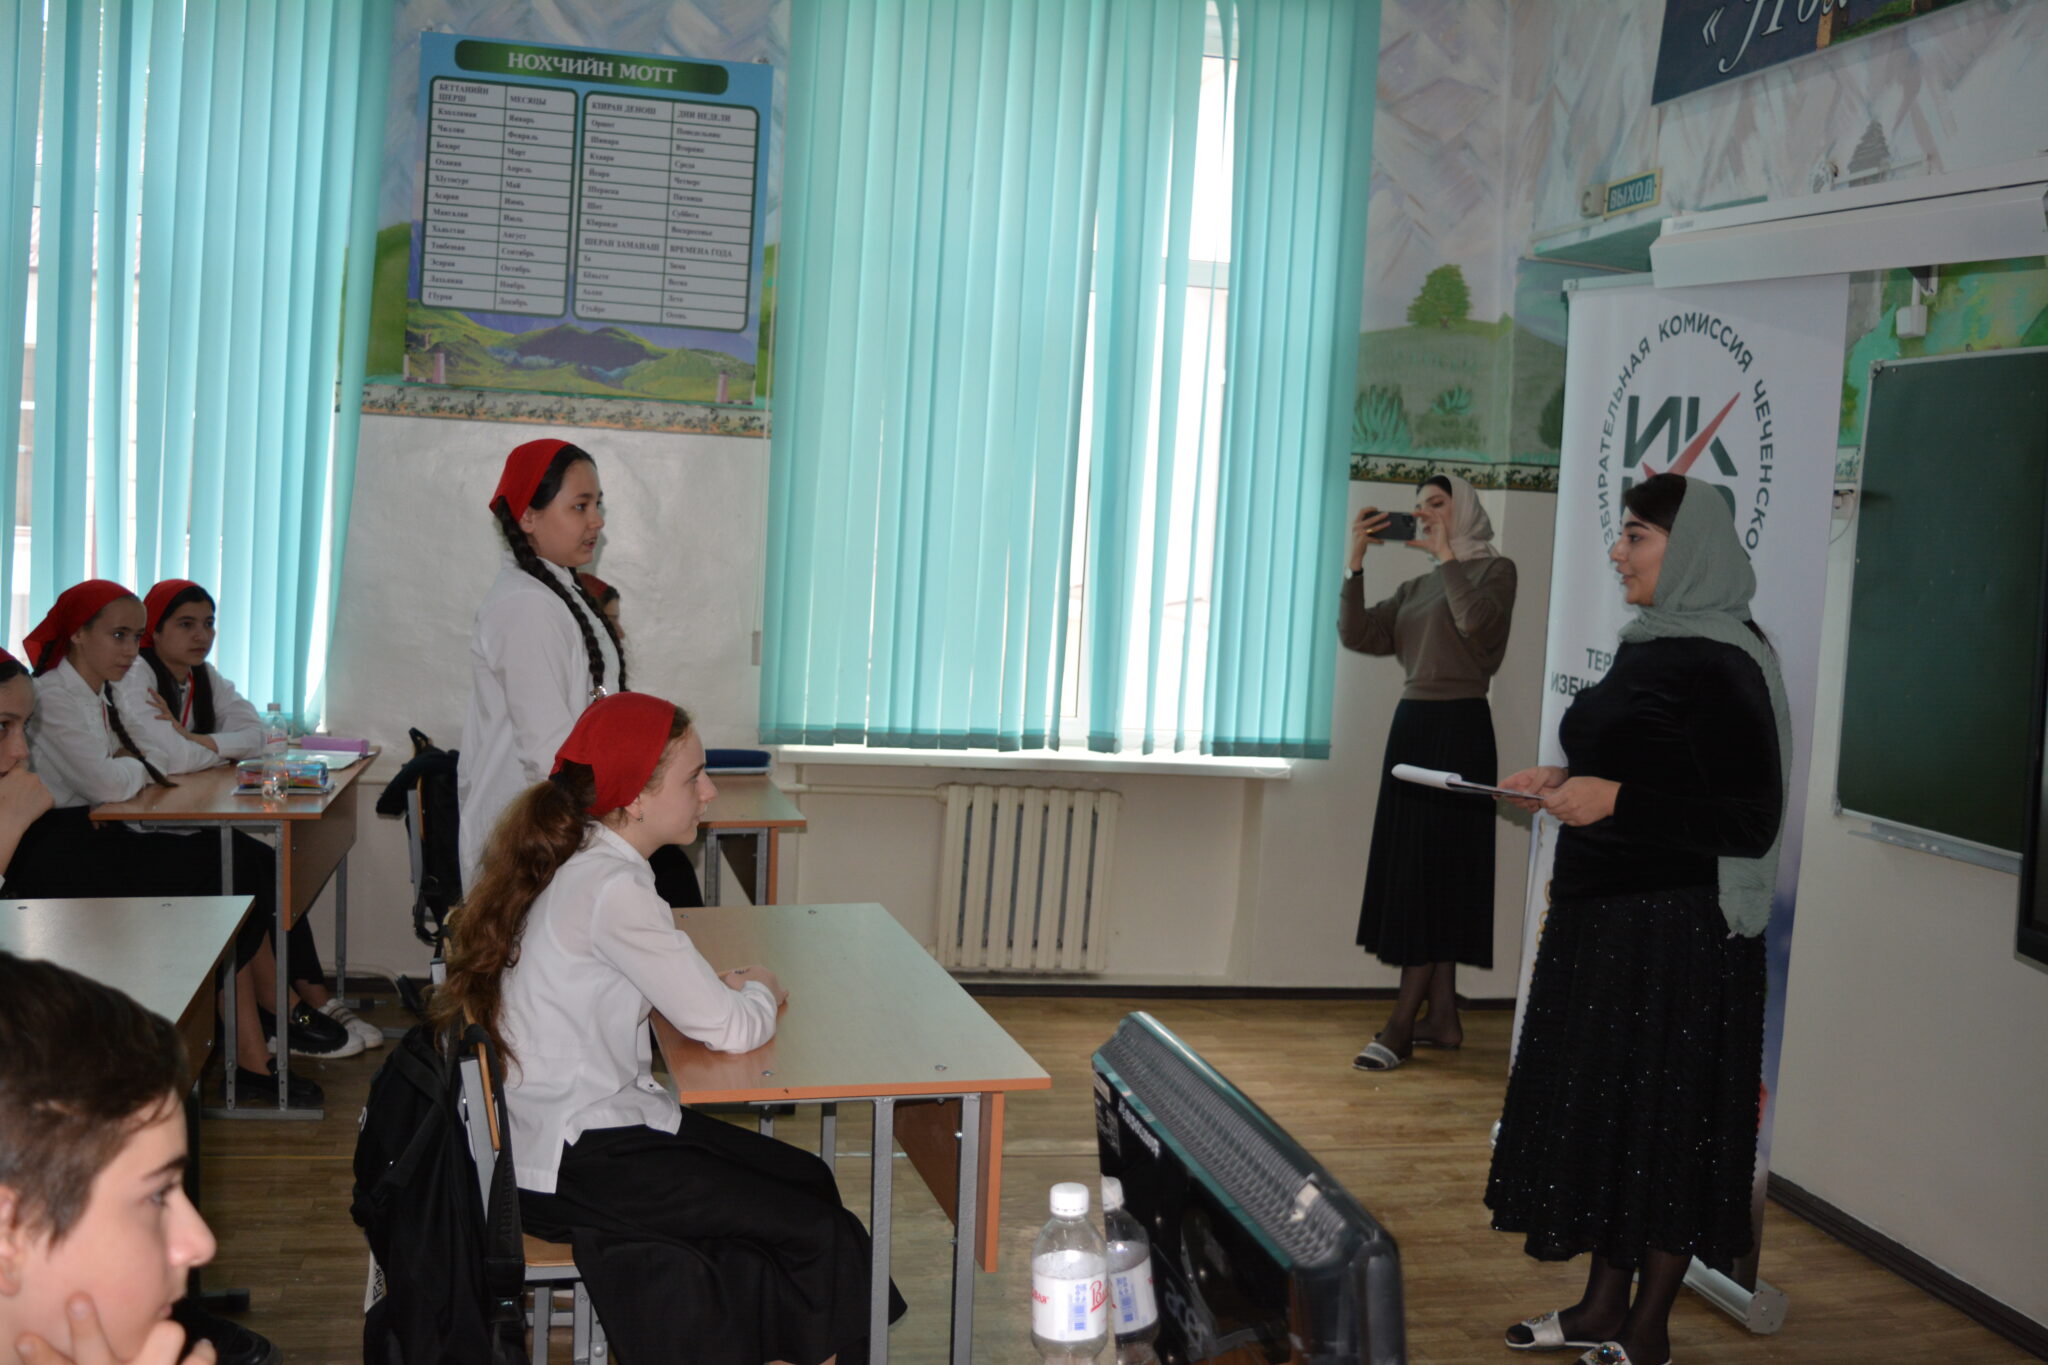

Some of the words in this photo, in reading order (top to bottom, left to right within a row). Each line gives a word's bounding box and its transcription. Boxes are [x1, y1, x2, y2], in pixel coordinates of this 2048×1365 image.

[508, 52, 613, 78] НОХЧИЙН
[619, 63, 677, 83] МОТТ
[510, 95, 546, 106] МЕСЯЦЫ
[677, 110, 695, 119] ДНИ
[697, 112, 731, 122] НЕДЕЛИ
[508, 148, 526, 156] Март
[506, 181, 520, 189] Май
[1610, 179, 1653, 210] ВЫХОД
[670, 245, 709, 256] ВРЕМЕНА
[711, 248, 732, 258] ГОДА
[1658, 312, 1754, 373] КОМИССИЯ
[1744, 379, 1773, 558] ЧЕЧЕНСКО
[1586, 648, 1613, 672] ТЕР
